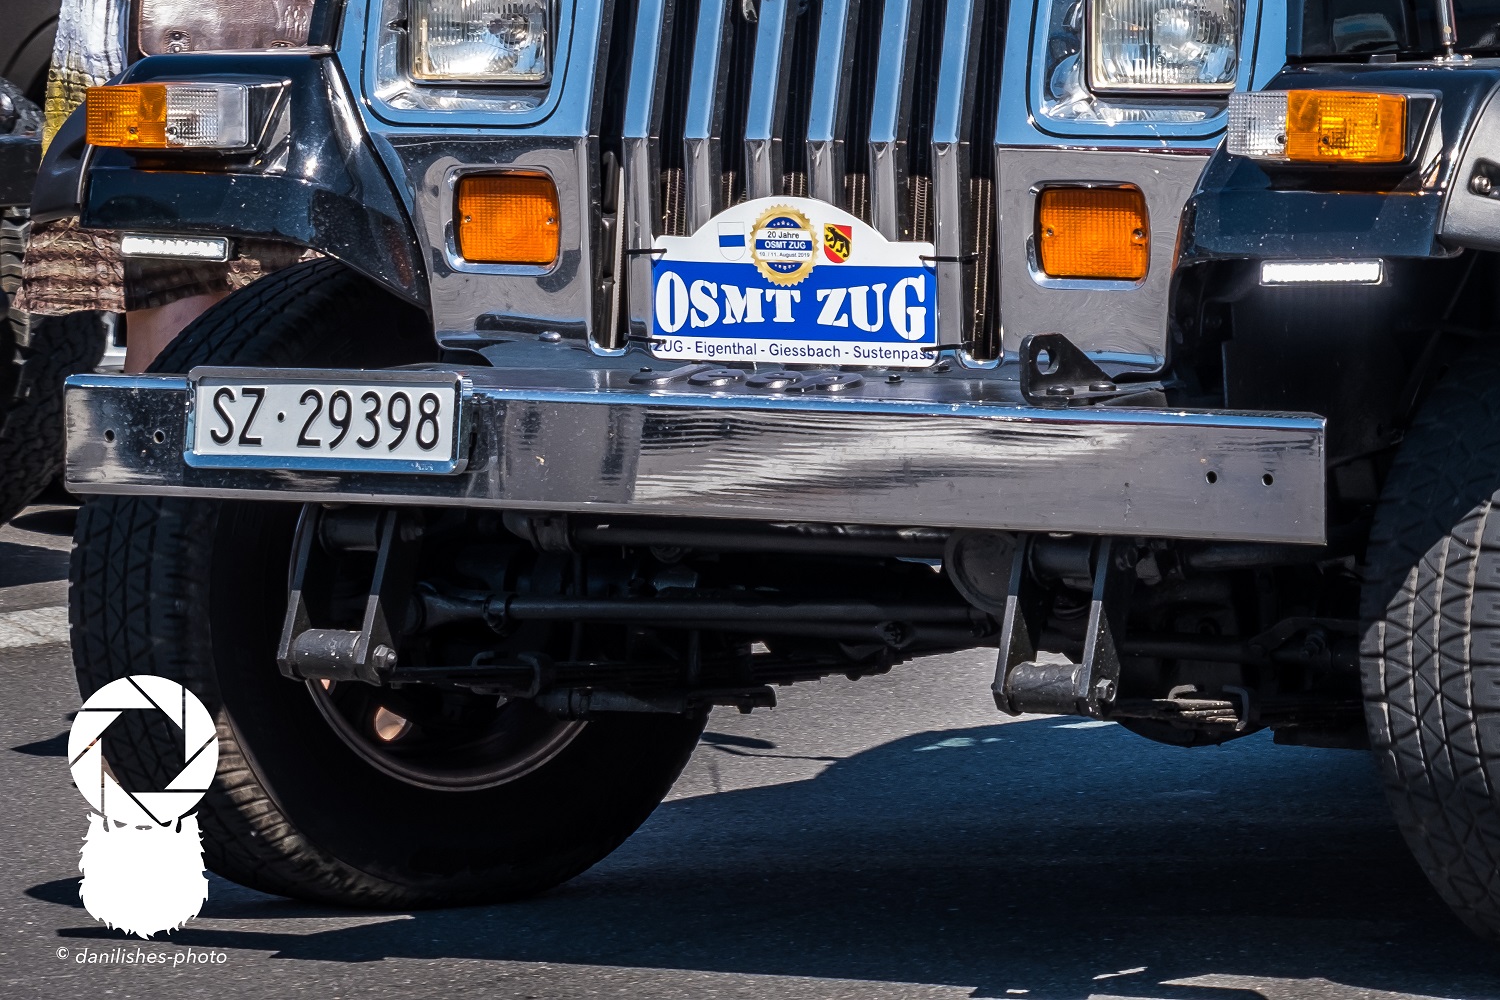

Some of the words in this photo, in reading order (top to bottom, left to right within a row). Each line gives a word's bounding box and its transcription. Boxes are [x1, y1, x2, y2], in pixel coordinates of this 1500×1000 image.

[764, 240, 787, 249] OSMT
[788, 241, 807, 250] ZUG
[767, 230, 777, 239] 20
[778, 231, 800, 239] Jahre
[655, 270, 801, 334] OSMT
[816, 274, 926, 341] ZUG
[695, 340, 757, 357] Eigenthal
[768, 343, 841, 358] Giessbach
[853, 345, 934, 362] Sustenpass
[628, 362, 867, 393] Jeep
